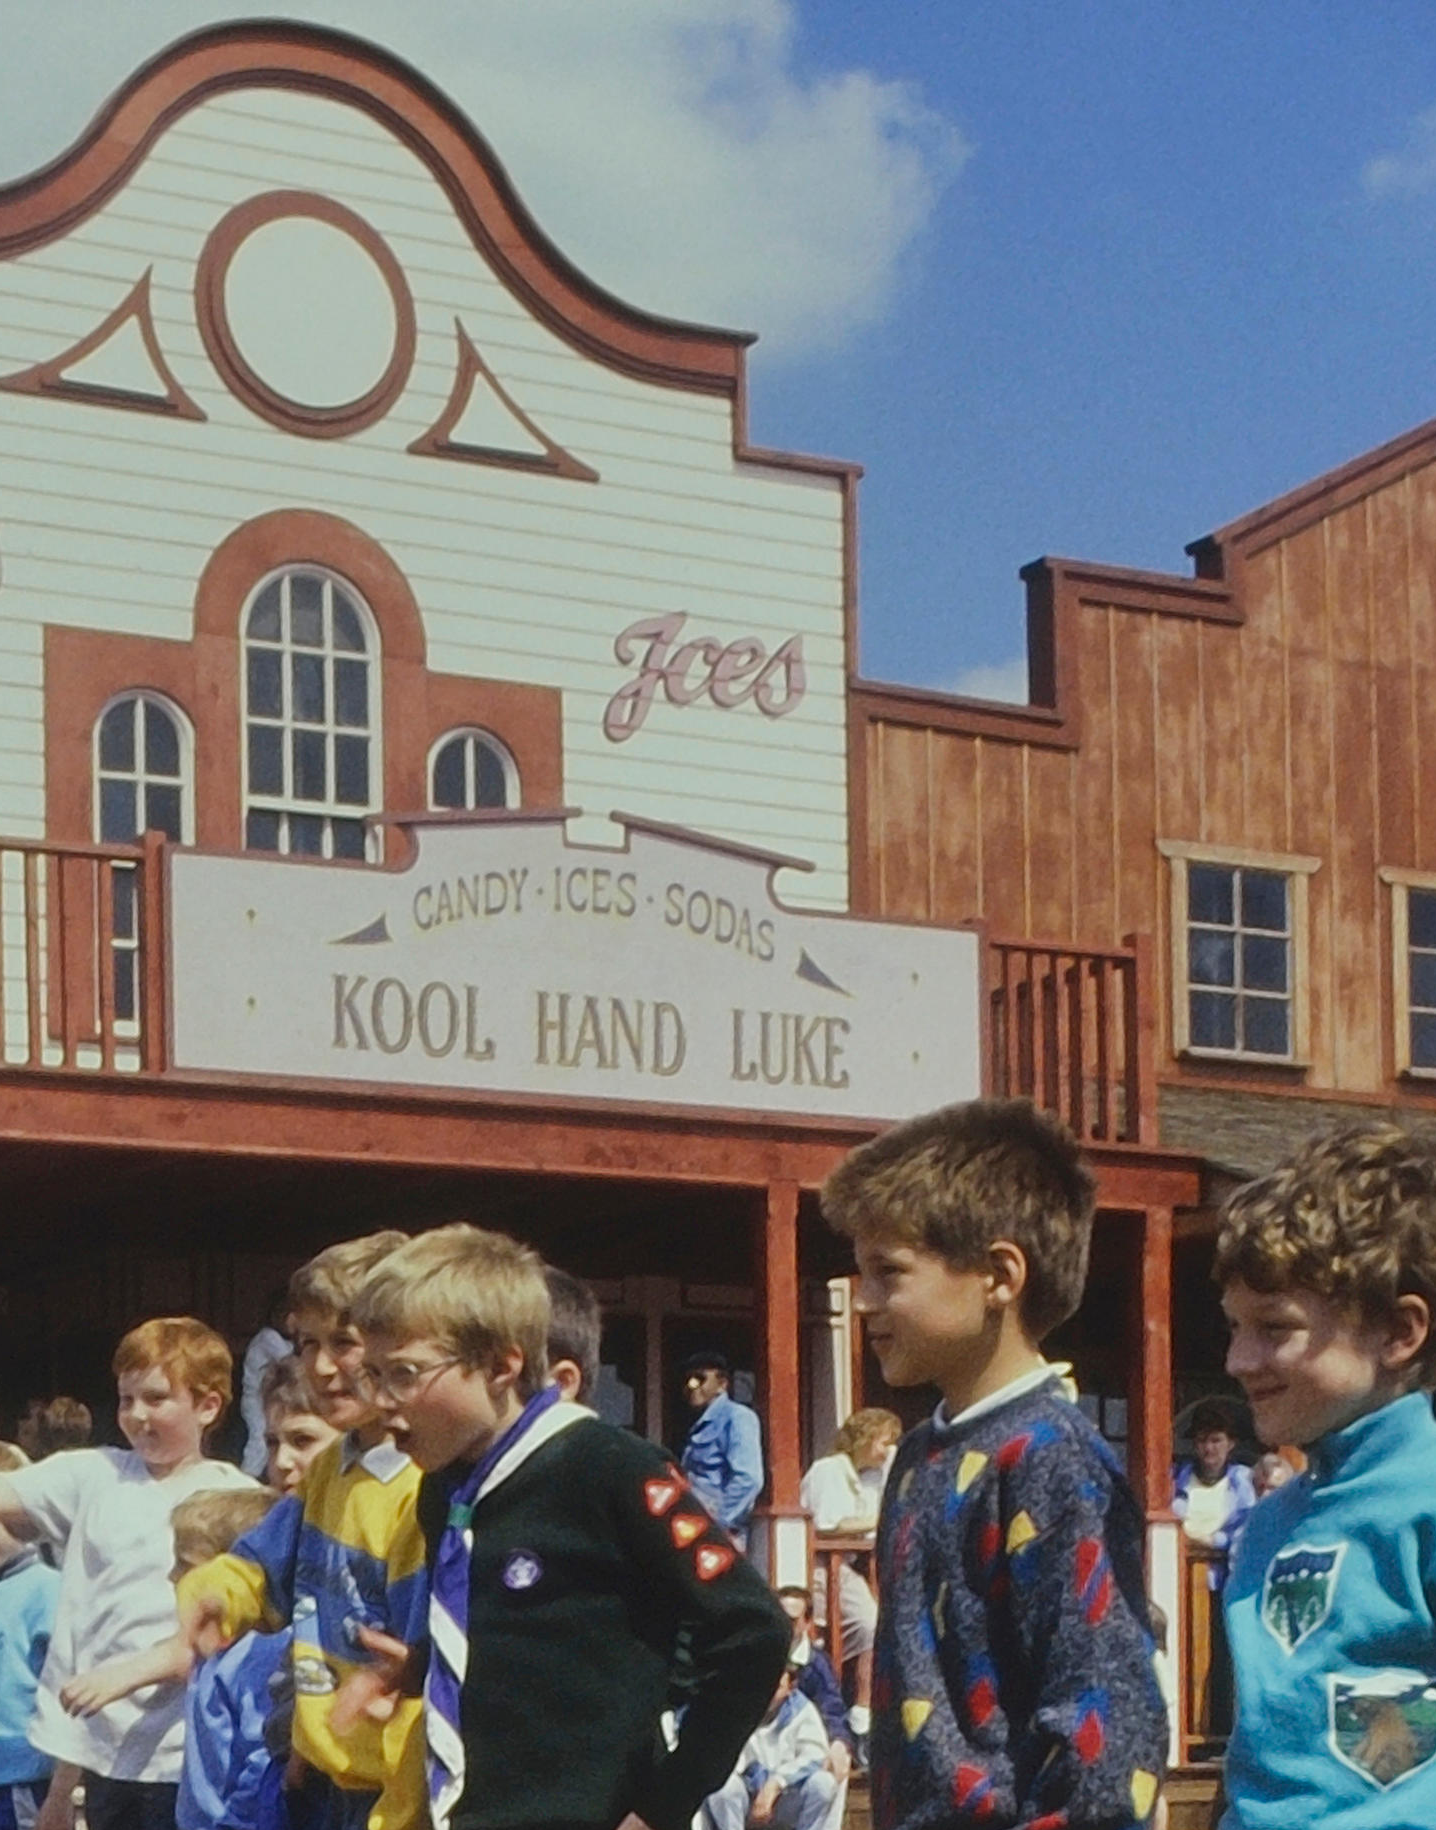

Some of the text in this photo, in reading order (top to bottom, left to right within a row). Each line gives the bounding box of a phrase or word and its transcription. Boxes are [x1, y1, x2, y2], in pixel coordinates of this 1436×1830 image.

[602, 609, 808, 744] Joes
[412, 865, 777, 963] CANDY ICES SODAS
[331, 973, 851, 1090] KOOL HAND LUKE
